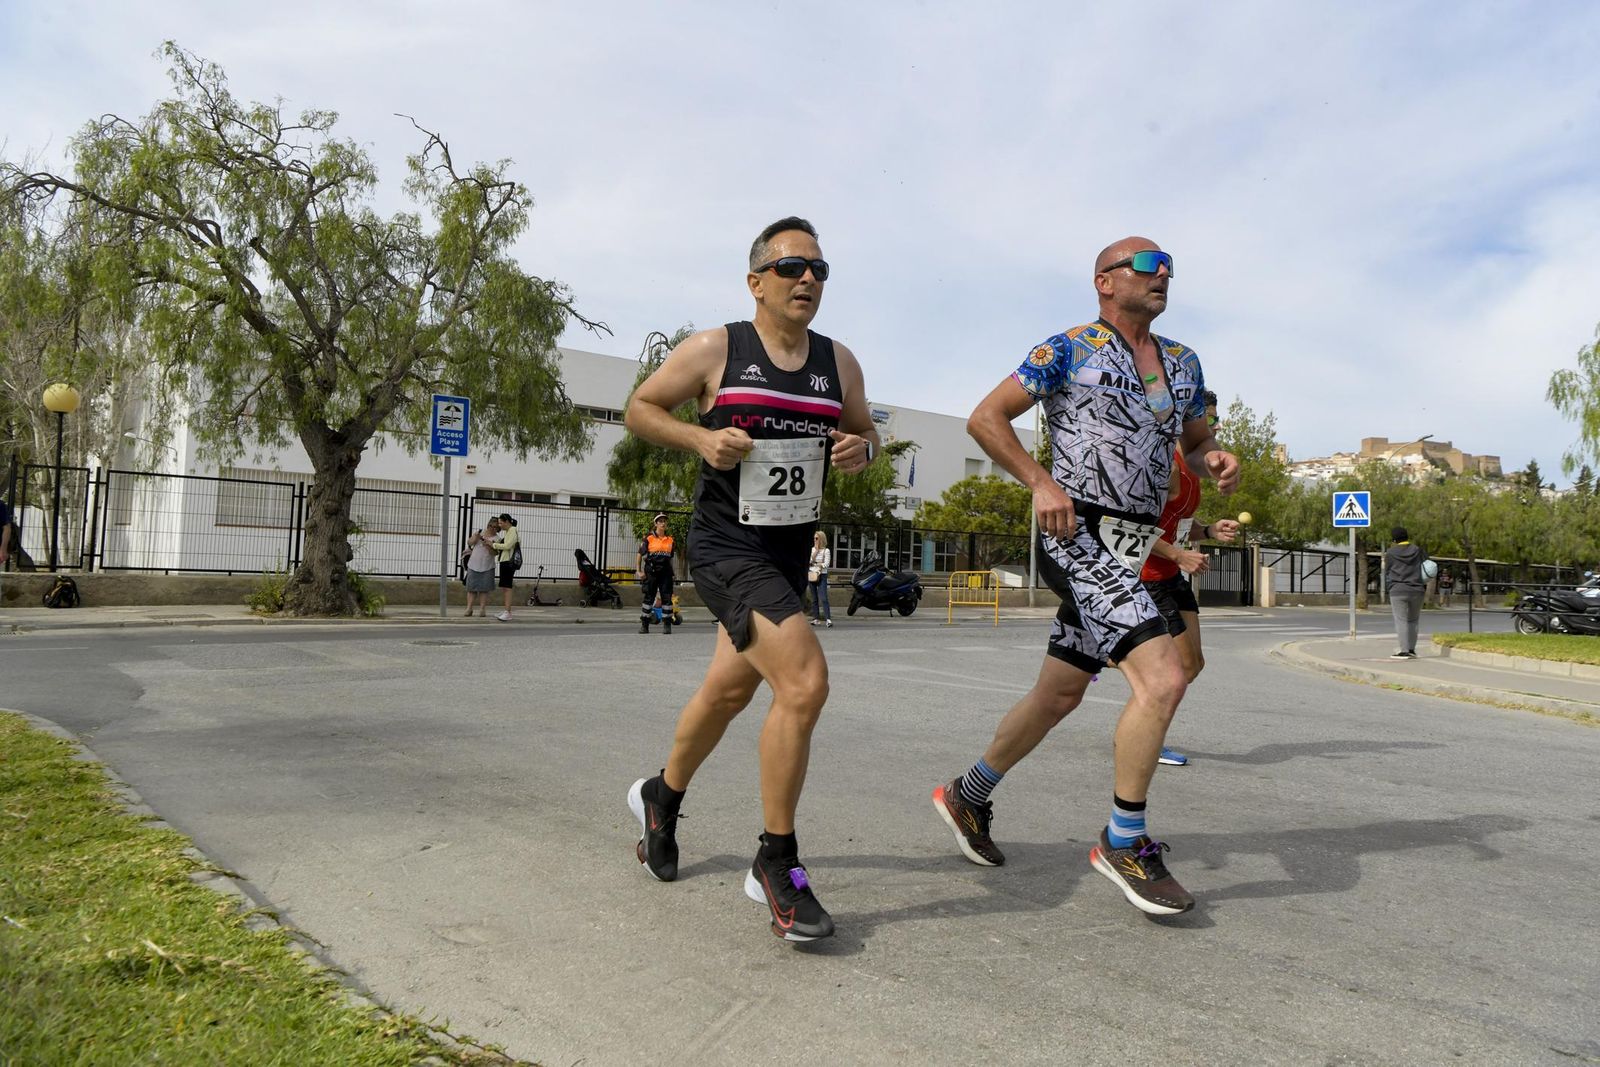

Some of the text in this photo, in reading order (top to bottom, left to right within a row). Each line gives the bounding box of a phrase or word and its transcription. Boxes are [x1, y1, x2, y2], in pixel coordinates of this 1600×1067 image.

[437, 430, 463, 439] Acceso
[440, 438, 460, 446] Playa
[768, 466, 806, 496] 28
